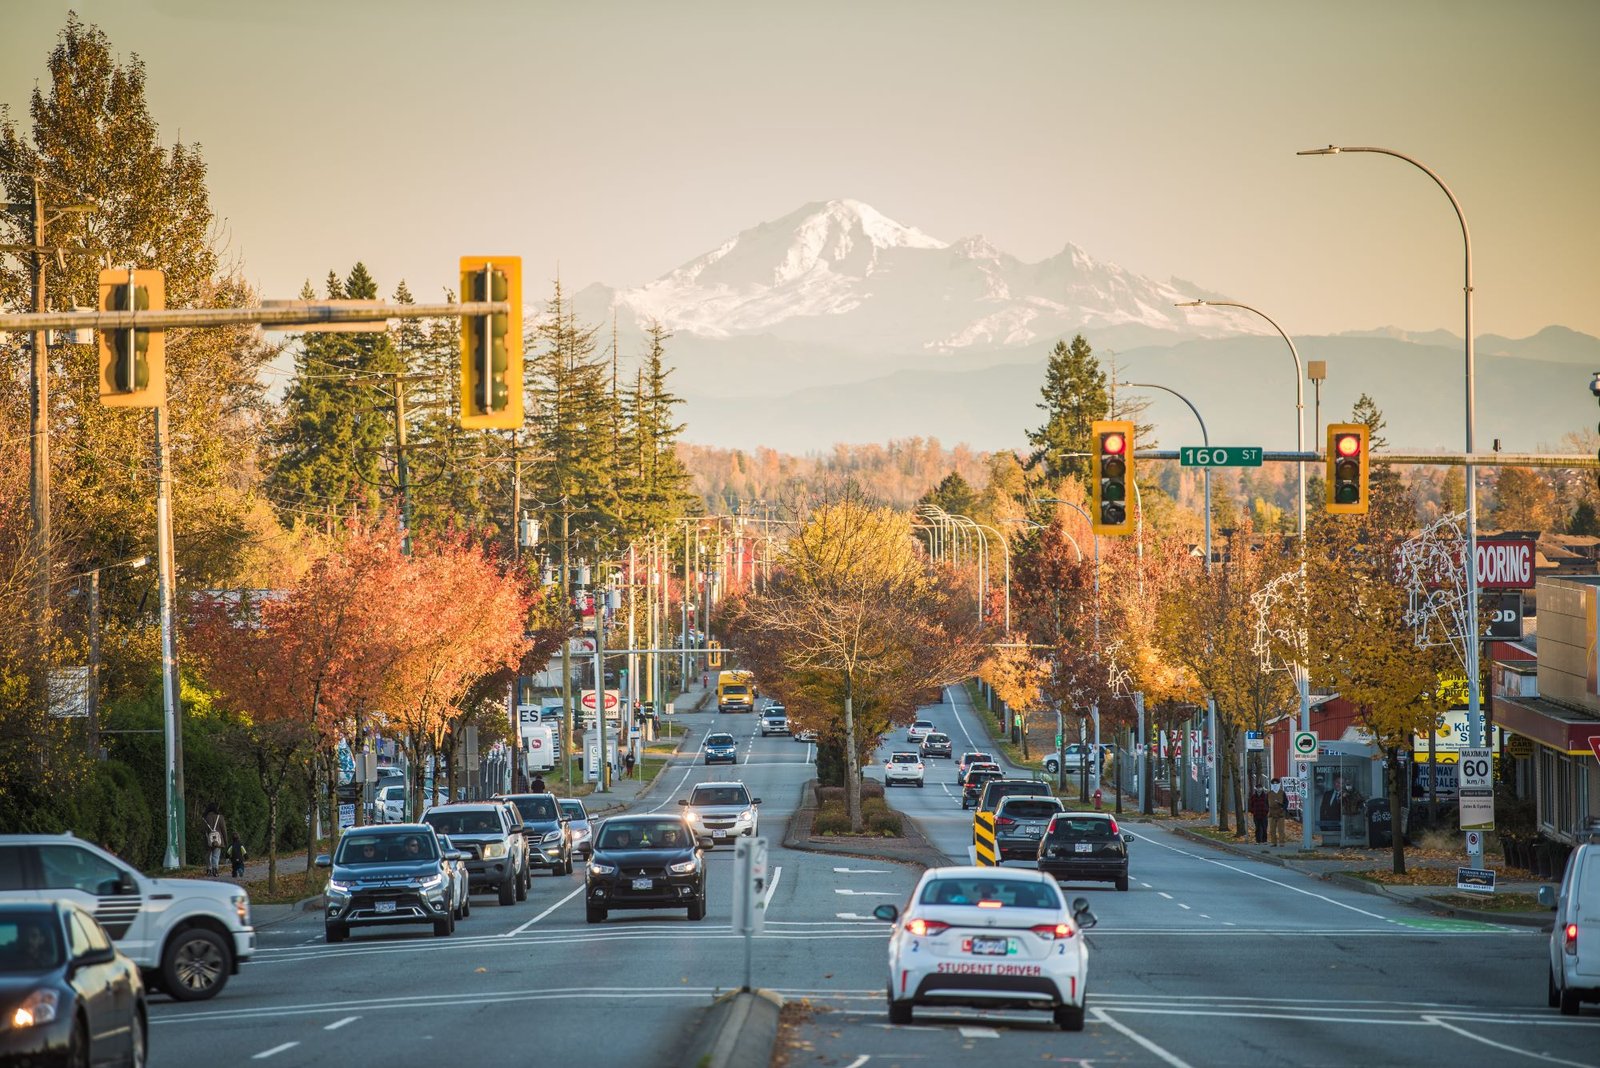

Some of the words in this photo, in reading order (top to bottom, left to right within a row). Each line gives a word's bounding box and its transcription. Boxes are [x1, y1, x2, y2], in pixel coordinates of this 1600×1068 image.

[1186, 449, 1228, 465] 160
[1242, 449, 1257, 460] ST
[1476, 544, 1530, 583] OORING
[1464, 712, 1486, 722] Te
[1163, 745, 1202, 757] WAH
[1419, 766, 1453, 776] HIGWAY
[1463, 760, 1489, 777] 60
[911, 941, 919, 952] 2
[1058, 943, 1065, 954] 2
[937, 962, 993, 975] STUDENT
[997, 964, 1041, 976] DRIVER
